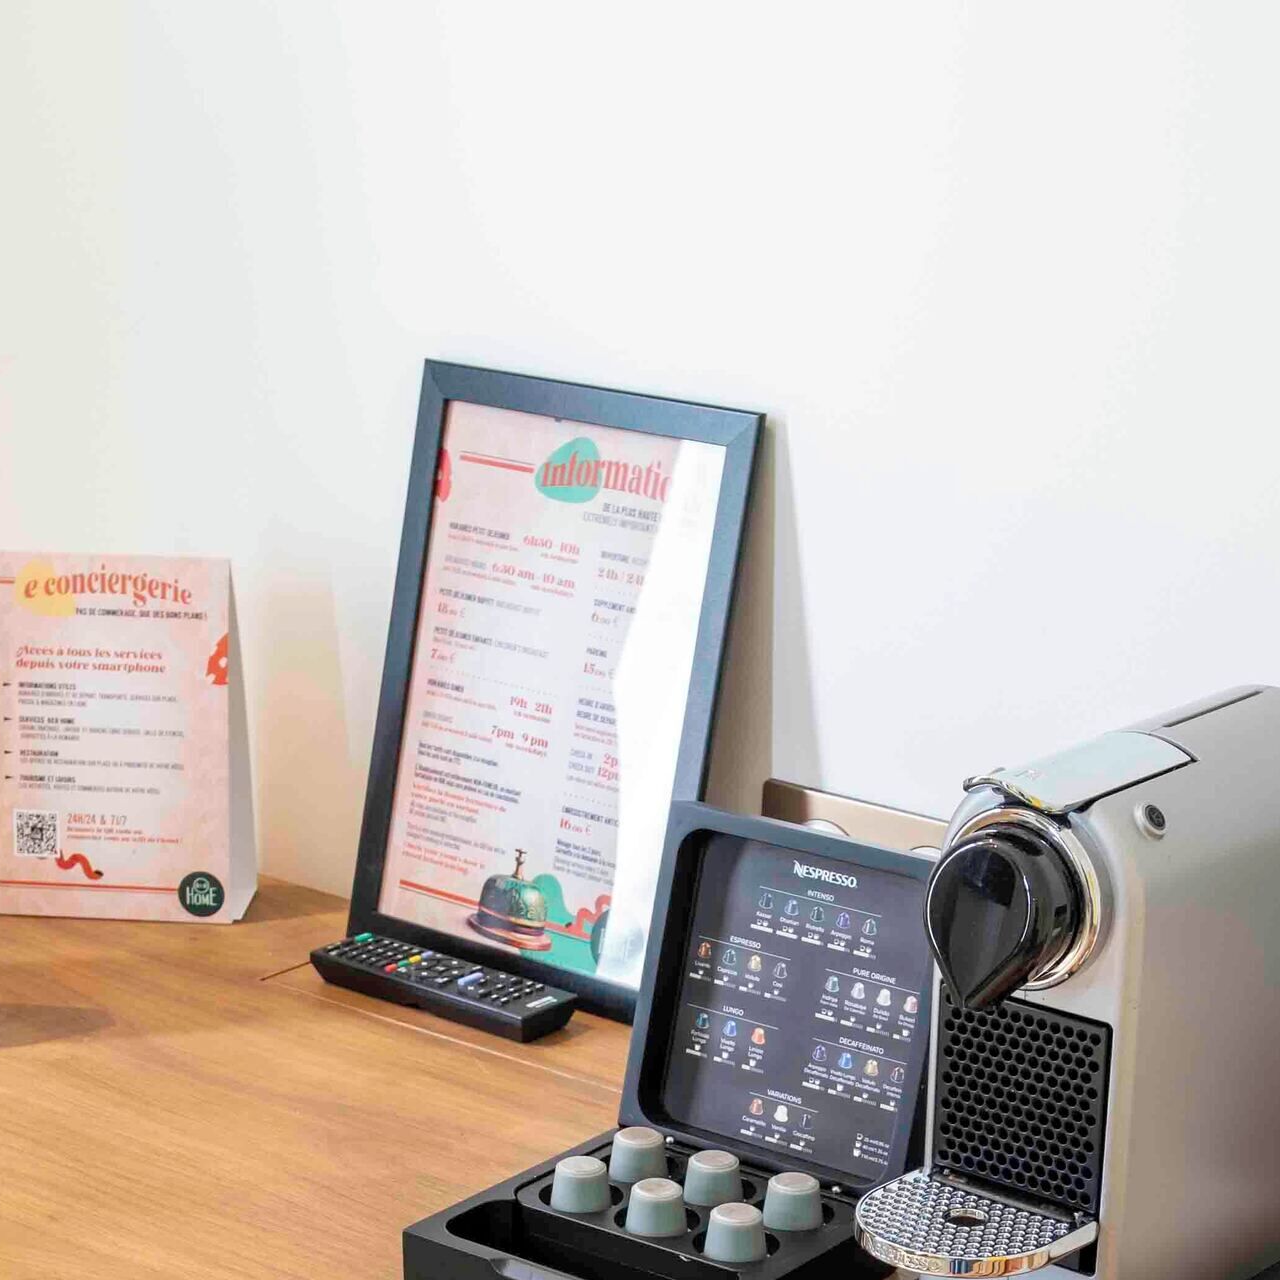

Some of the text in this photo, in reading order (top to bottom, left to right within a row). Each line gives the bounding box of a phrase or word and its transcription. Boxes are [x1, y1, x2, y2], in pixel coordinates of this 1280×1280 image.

[24, 563, 192, 608] e conciergerie
[16, 658, 166, 675] depuis votre smartphone
[793, 860, 858, 888] NESPRESSO
[807, 890, 834, 902] INTENSO
[730, 935, 761, 949] ESPRESSO
[852, 967, 896, 984] PURE ORIGINE
[723, 1005, 744, 1016] LUNGO
[840, 1037, 884, 1055] DECAFFEINATO
[767, 1088, 802, 1105] VARIATIONS
